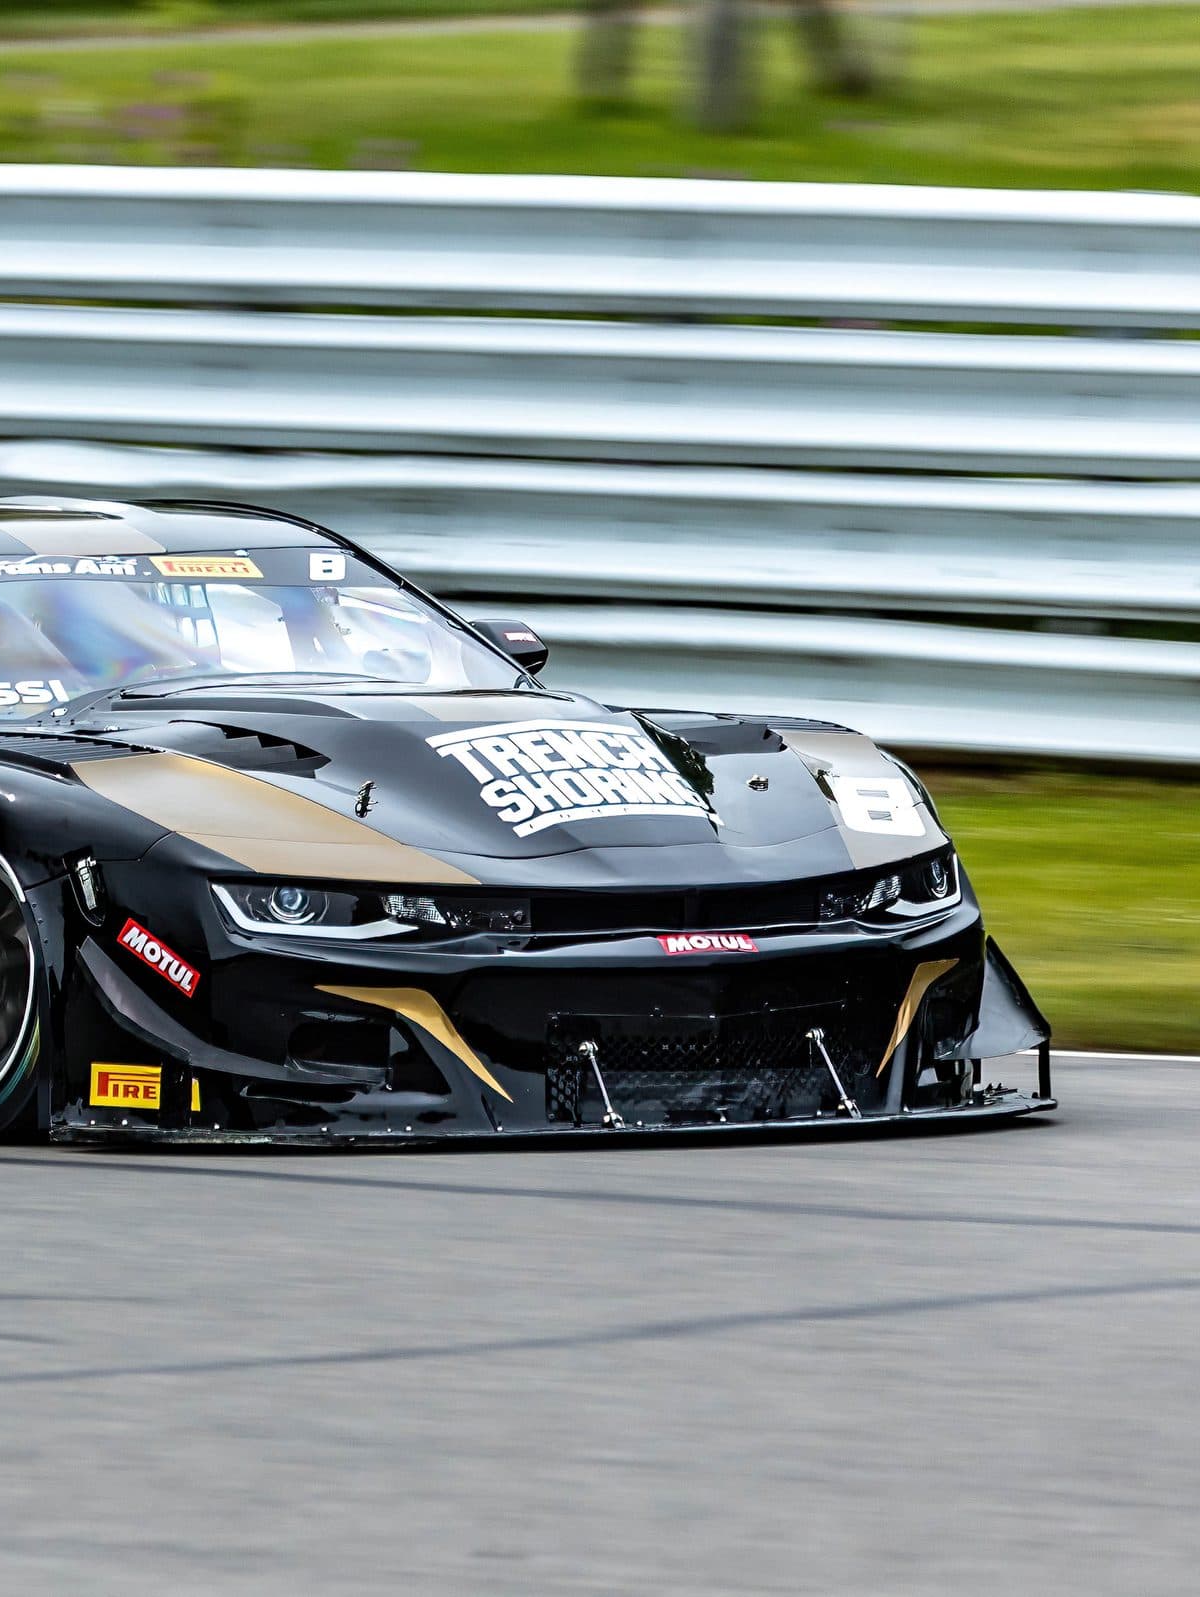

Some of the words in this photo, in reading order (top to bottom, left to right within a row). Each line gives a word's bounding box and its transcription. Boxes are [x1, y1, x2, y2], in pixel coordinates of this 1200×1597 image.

[163, 560, 250, 575] PIRELLI
[309, 553, 346, 580] 8
[436, 730, 680, 785] TRENCH
[480, 768, 710, 823] SHORING
[831, 776, 926, 837] 8
[123, 926, 194, 992] MOTUL
[667, 934, 753, 953] MOTUL
